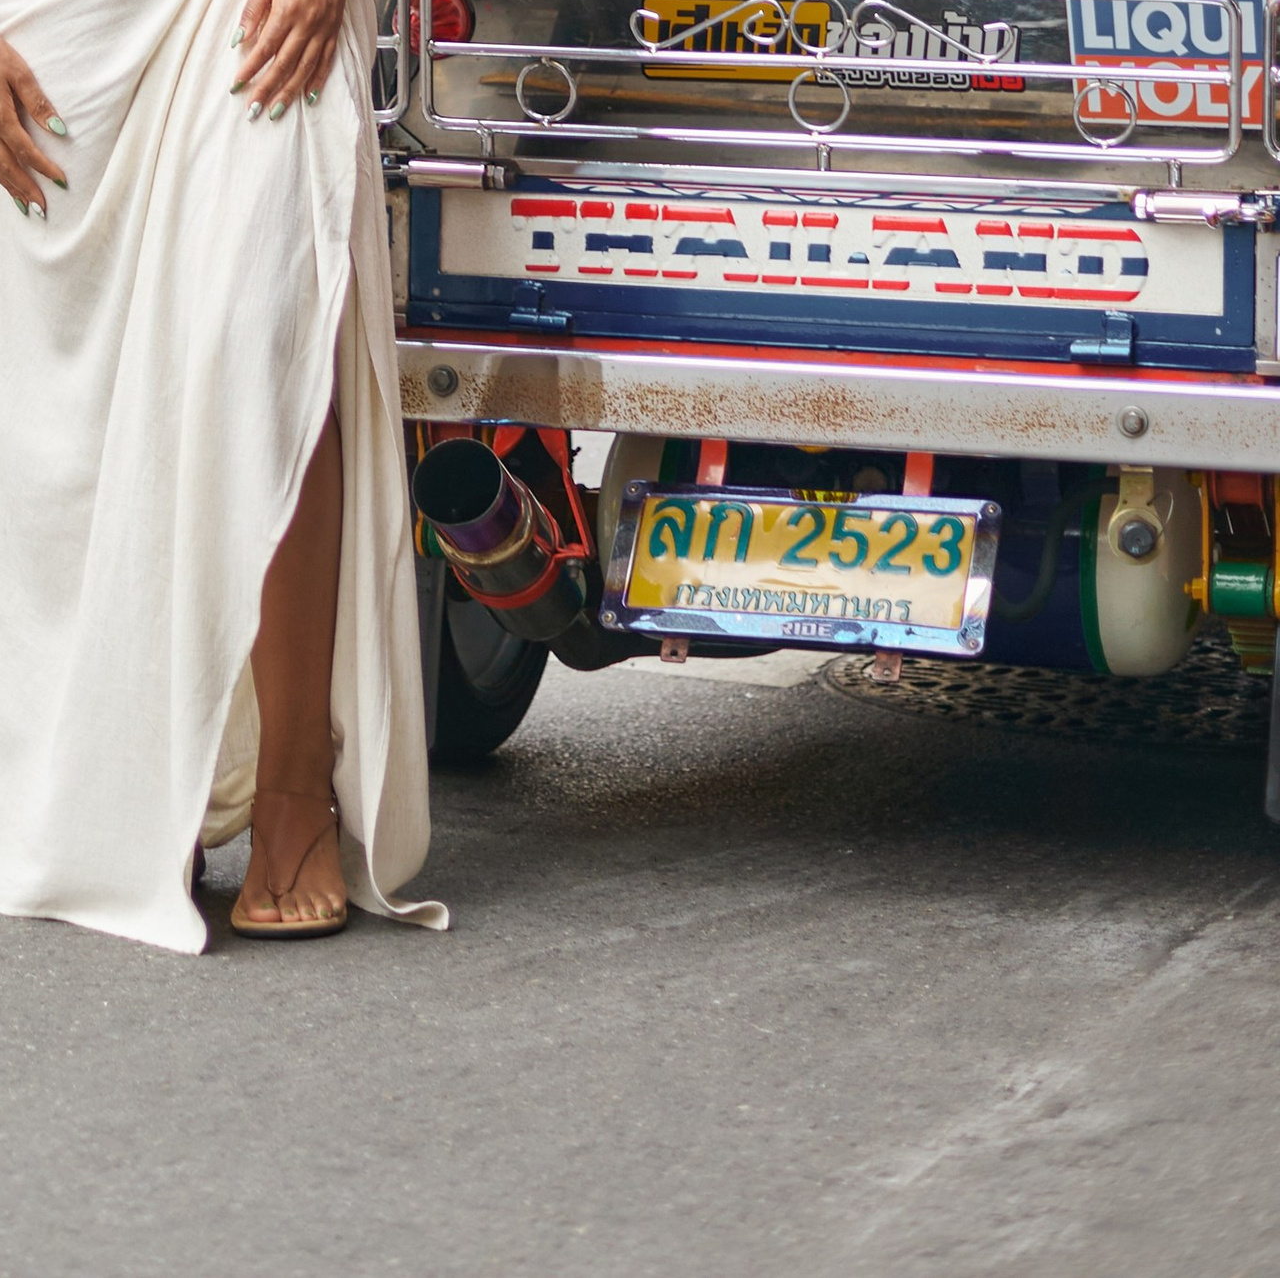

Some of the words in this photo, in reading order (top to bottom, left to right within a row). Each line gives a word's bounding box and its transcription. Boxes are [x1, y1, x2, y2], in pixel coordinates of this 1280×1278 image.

[1085, 60, 1263, 118] MOLY
[511, 198, 1150, 302] THAILAND
[780, 505, 965, 578] 2523
